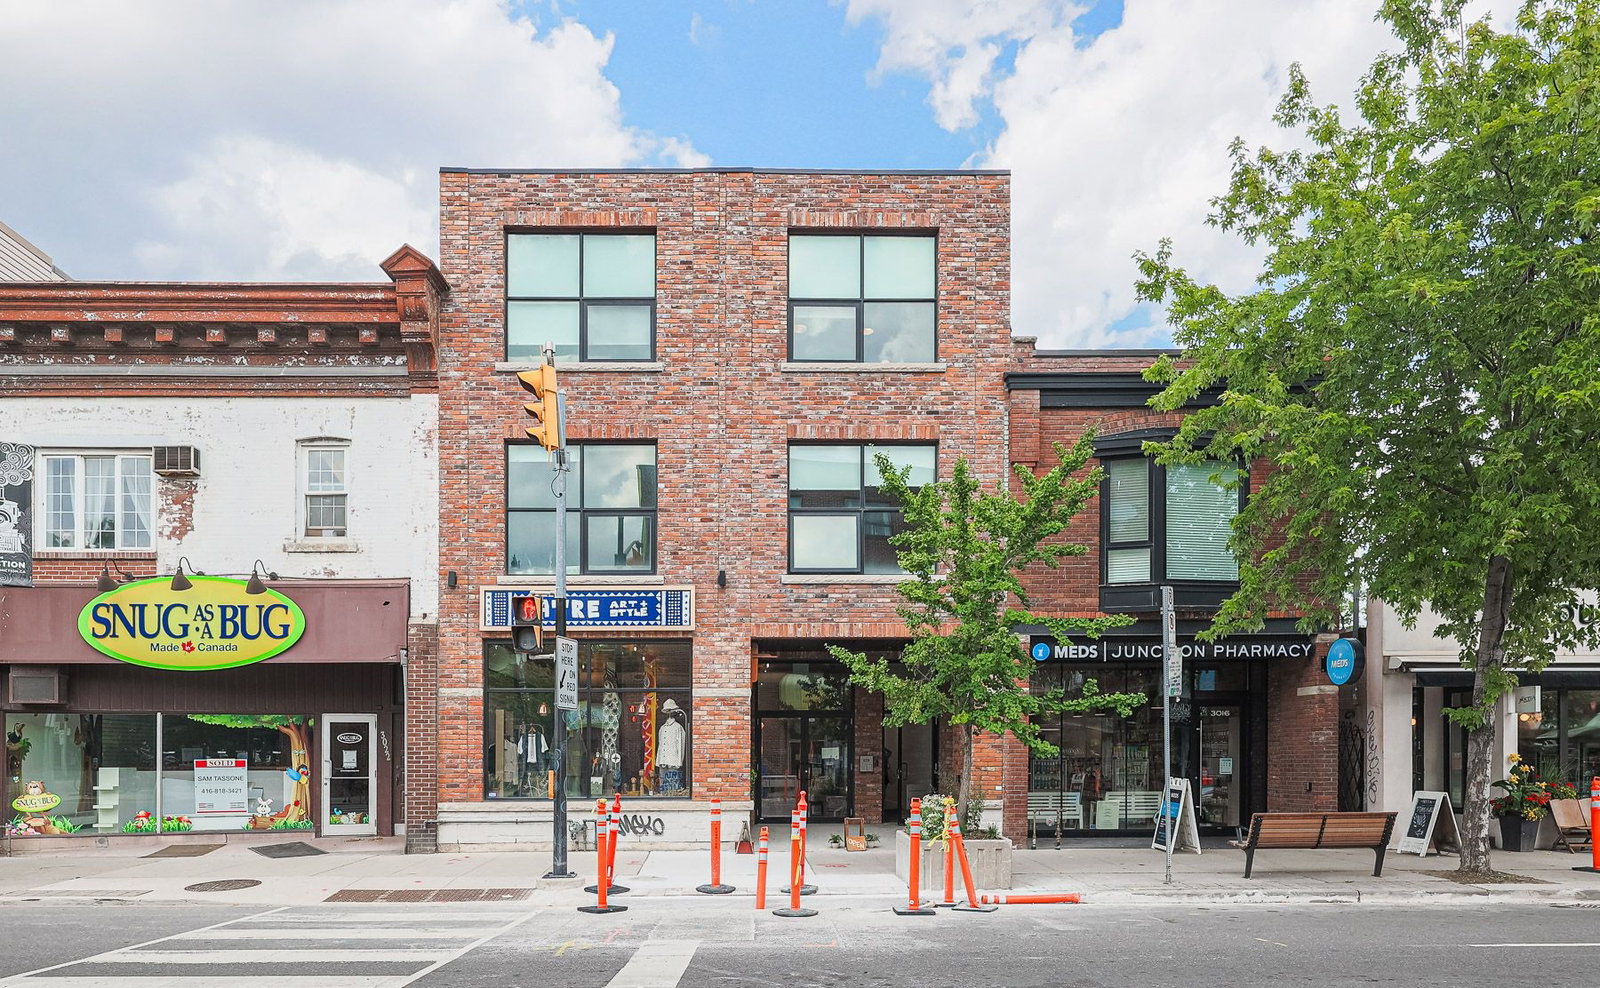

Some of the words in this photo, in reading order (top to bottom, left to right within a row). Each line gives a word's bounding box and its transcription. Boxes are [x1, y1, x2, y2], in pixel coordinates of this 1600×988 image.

[0, 561, 26, 569] TION
[610, 600, 638, 609] ART
[193, 604, 214, 622] AS
[609, 607, 648, 617] STYLE
[91, 603, 190, 640] SNUG
[218, 604, 290, 640] BUG
[200, 622, 214, 639] A
[150, 643, 180, 652] Made
[197, 643, 238, 652] Canada
[562, 643, 573, 654] STOP
[1054, 645, 1098, 659] MEDS
[1111, 644, 1205, 659] JUNCON
[1213, 644, 1312, 658] PHARMACY
[562, 656, 573, 667] HERE
[1331, 659, 1349, 669] MEDS
[569, 670, 576, 679] ON
[567, 682, 576, 692] RED
[560, 694, 576, 705] SIGNAL
[380, 731, 391, 761] 3022
[848, 838, 865, 849] OPEN
